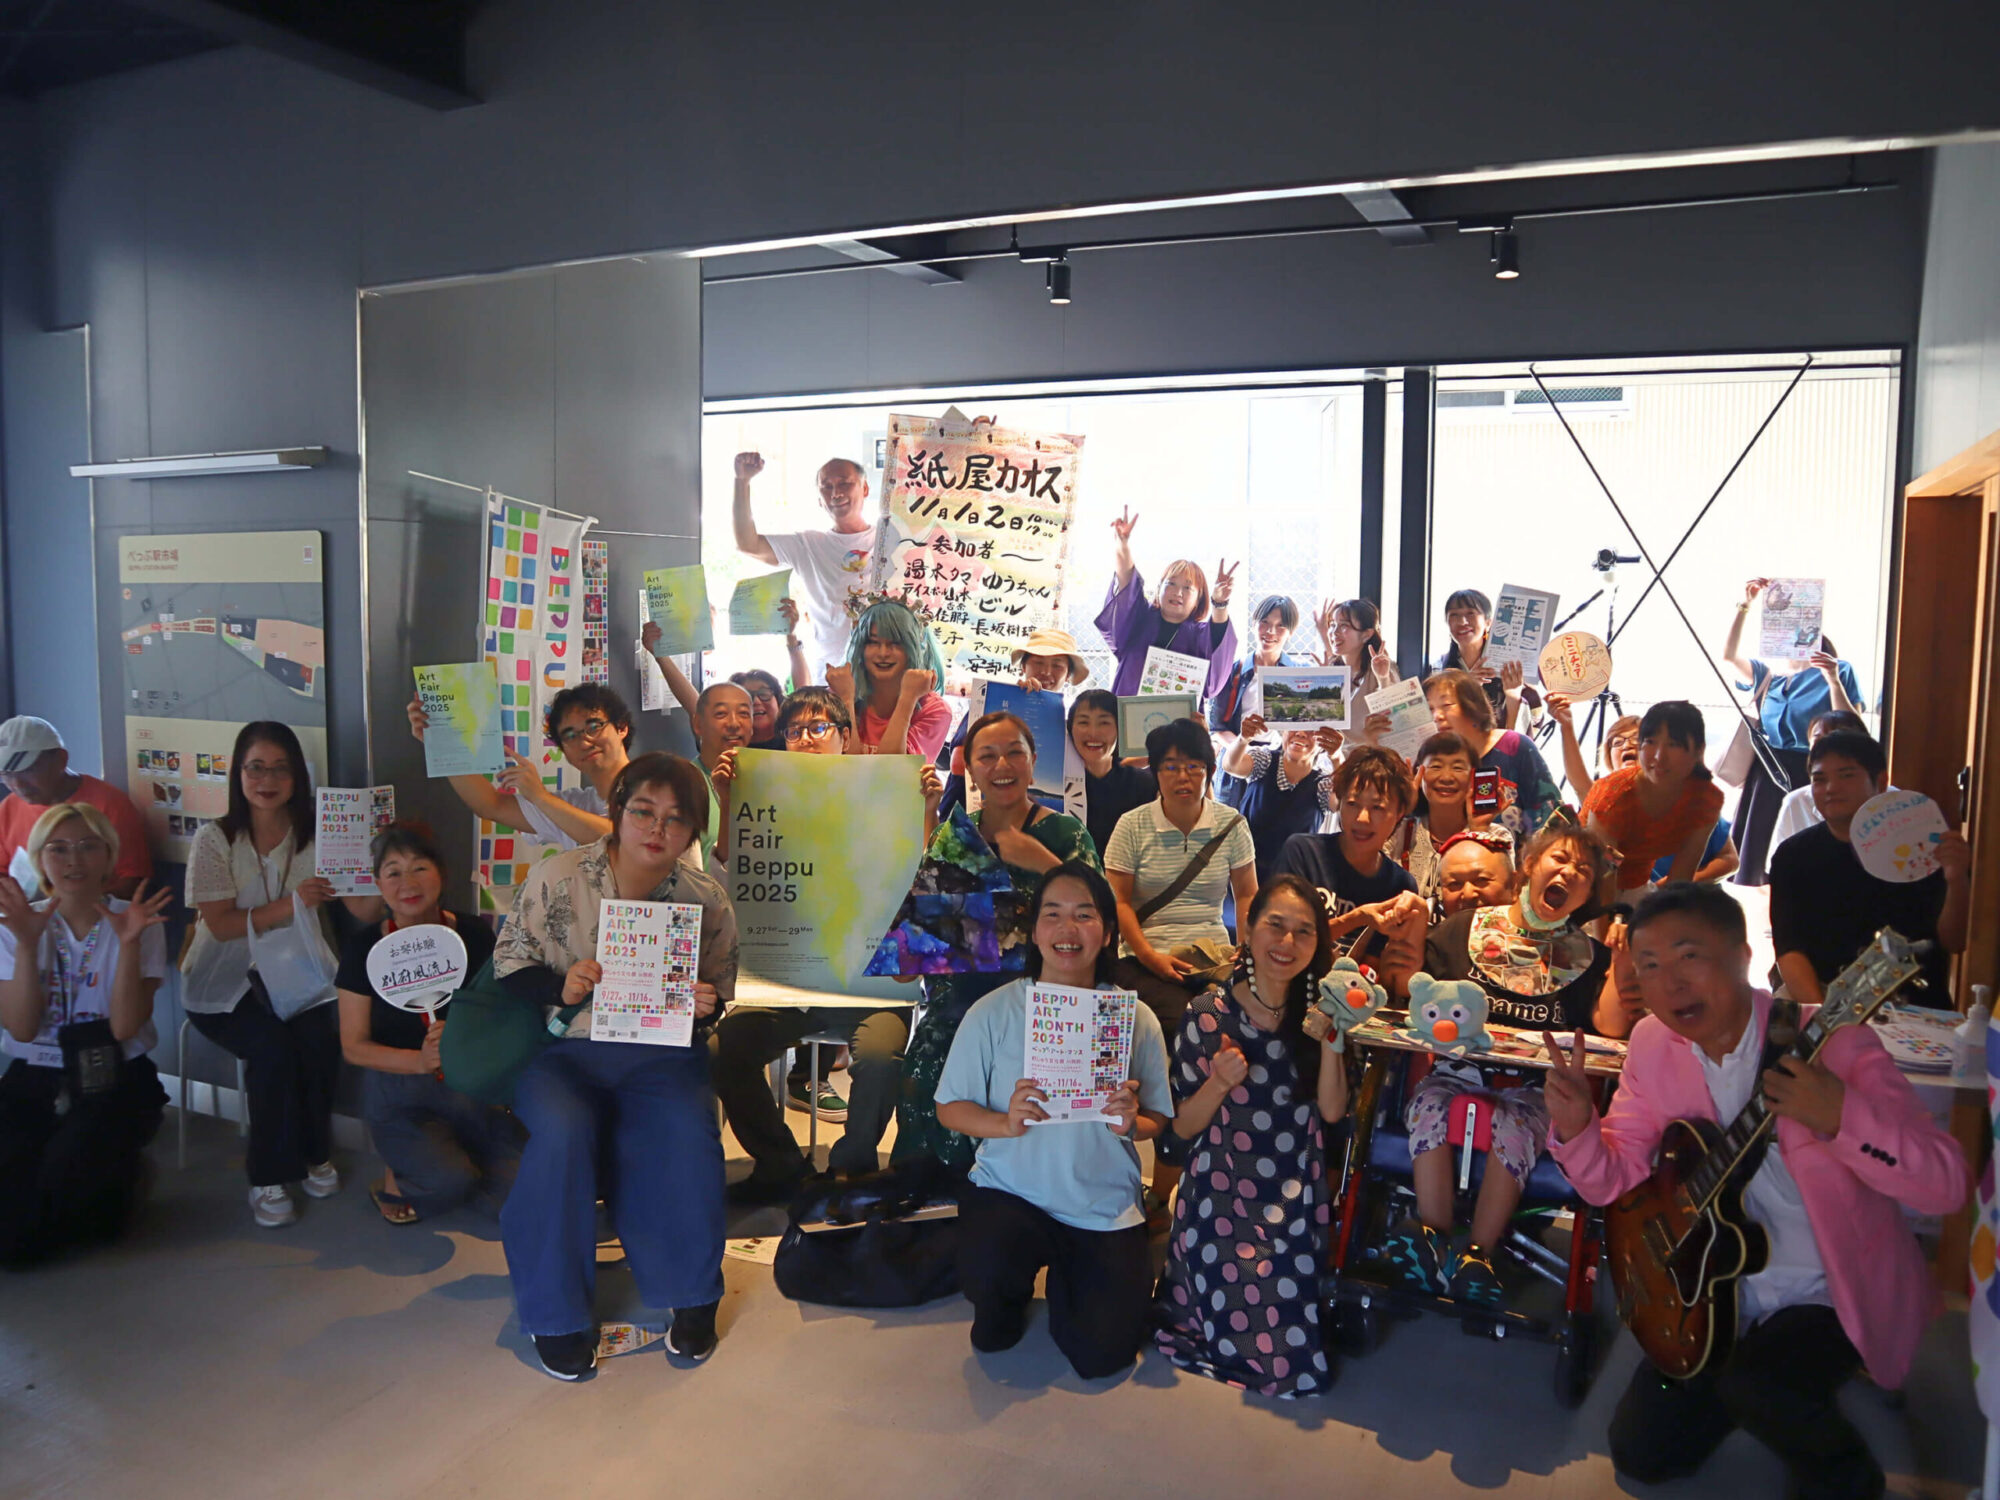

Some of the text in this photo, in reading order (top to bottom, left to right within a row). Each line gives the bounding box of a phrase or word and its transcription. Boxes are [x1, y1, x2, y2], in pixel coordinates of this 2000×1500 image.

[905, 450, 1062, 503] 紙屋カオス
[982, 572, 1050, 599] ゆうちゃん
[649, 592, 673, 601] Beppu
[650, 600, 669, 608] 2025
[979, 598, 1027, 616] ビル
[544, 546, 570, 688] BEPPU
[418, 673, 436, 682] Art
[420, 683, 440, 692] Fair
[422, 693, 455, 704] Beppu
[424, 704, 450, 713] 2025
[322, 793, 359, 802] BEPPU
[322, 803, 346, 812] ART
[736, 802, 777, 822] Art
[322, 813, 365, 822] MONTH
[322, 824, 349, 833] 2025
[738, 828, 783, 849] Fair
[737, 855, 813, 880] Beppu
[736, 883, 797, 903] 2025
[607, 905, 653, 918] BEPPU
[607, 919, 635, 930] ART
[605, 932, 658, 945] MONTH
[390, 938, 436, 958] お琴体験
[604, 945, 637, 957] 2025
[1033, 992, 1078, 1006] BEPPU
[1033, 1006, 1061, 1018] ART
[1032, 1019, 1084, 1032] MONTH
[1032, 1032, 1064, 1045] 2025
